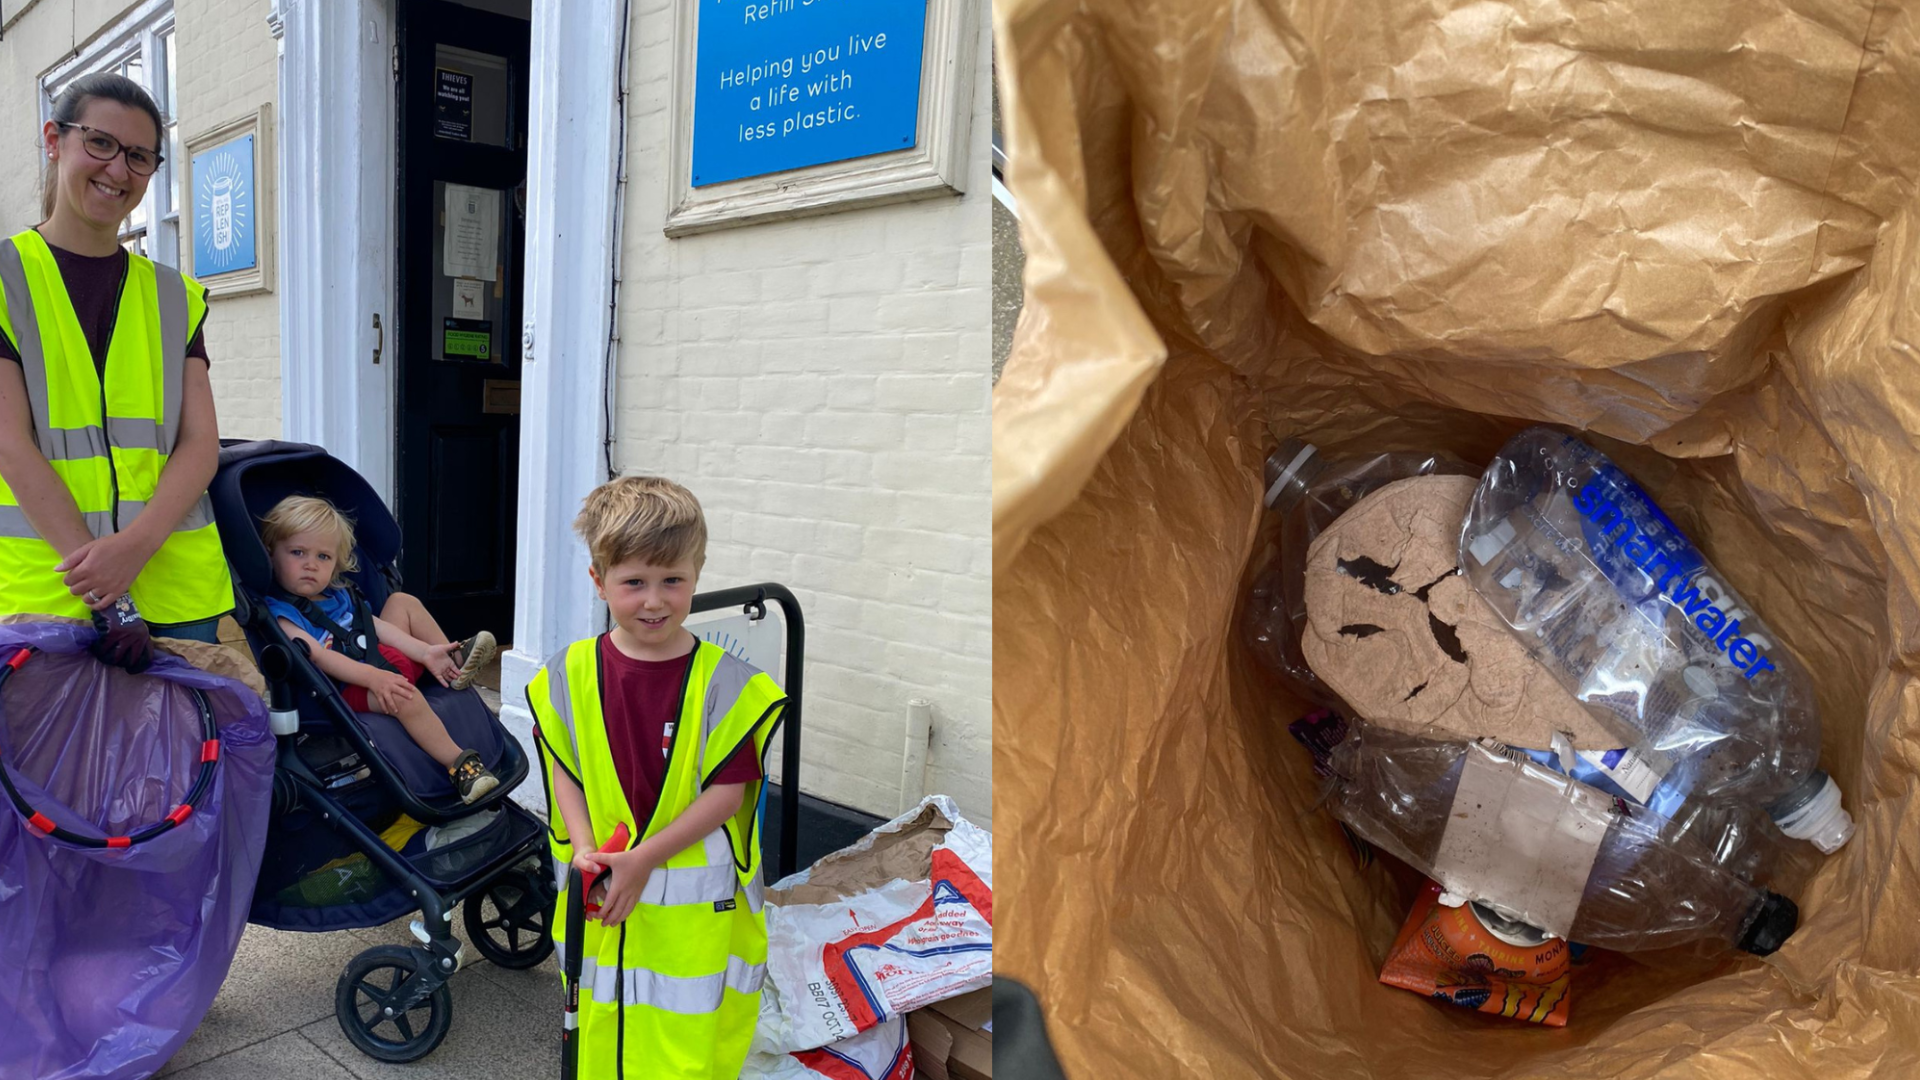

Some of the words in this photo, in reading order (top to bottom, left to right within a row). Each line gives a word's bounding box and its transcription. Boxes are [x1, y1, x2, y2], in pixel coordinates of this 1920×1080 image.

[720, 57, 793, 90] Helping
[801, 45, 840, 73] you
[848, 33, 887, 56] live
[442, 72, 467, 85] THIEVES
[750, 96, 761, 110] a
[769, 86, 799, 107] life
[807, 70, 852, 97] with
[437, 91, 459, 101] watching
[739, 124, 776, 142] less
[783, 102, 861, 137] plastic.
[216, 203, 230, 217] REP
[216, 218, 230, 231] LEN
[216, 231, 228, 245] ISH
[1573, 485, 1776, 680] smartwater
[843, 927, 857, 936] EASY
[1430, 924, 1461, 962] JUICED
[1479, 940, 1526, 965] TAURINE
[807, 982, 830, 1008] BB07
[822, 1011, 841, 1031] OCT
